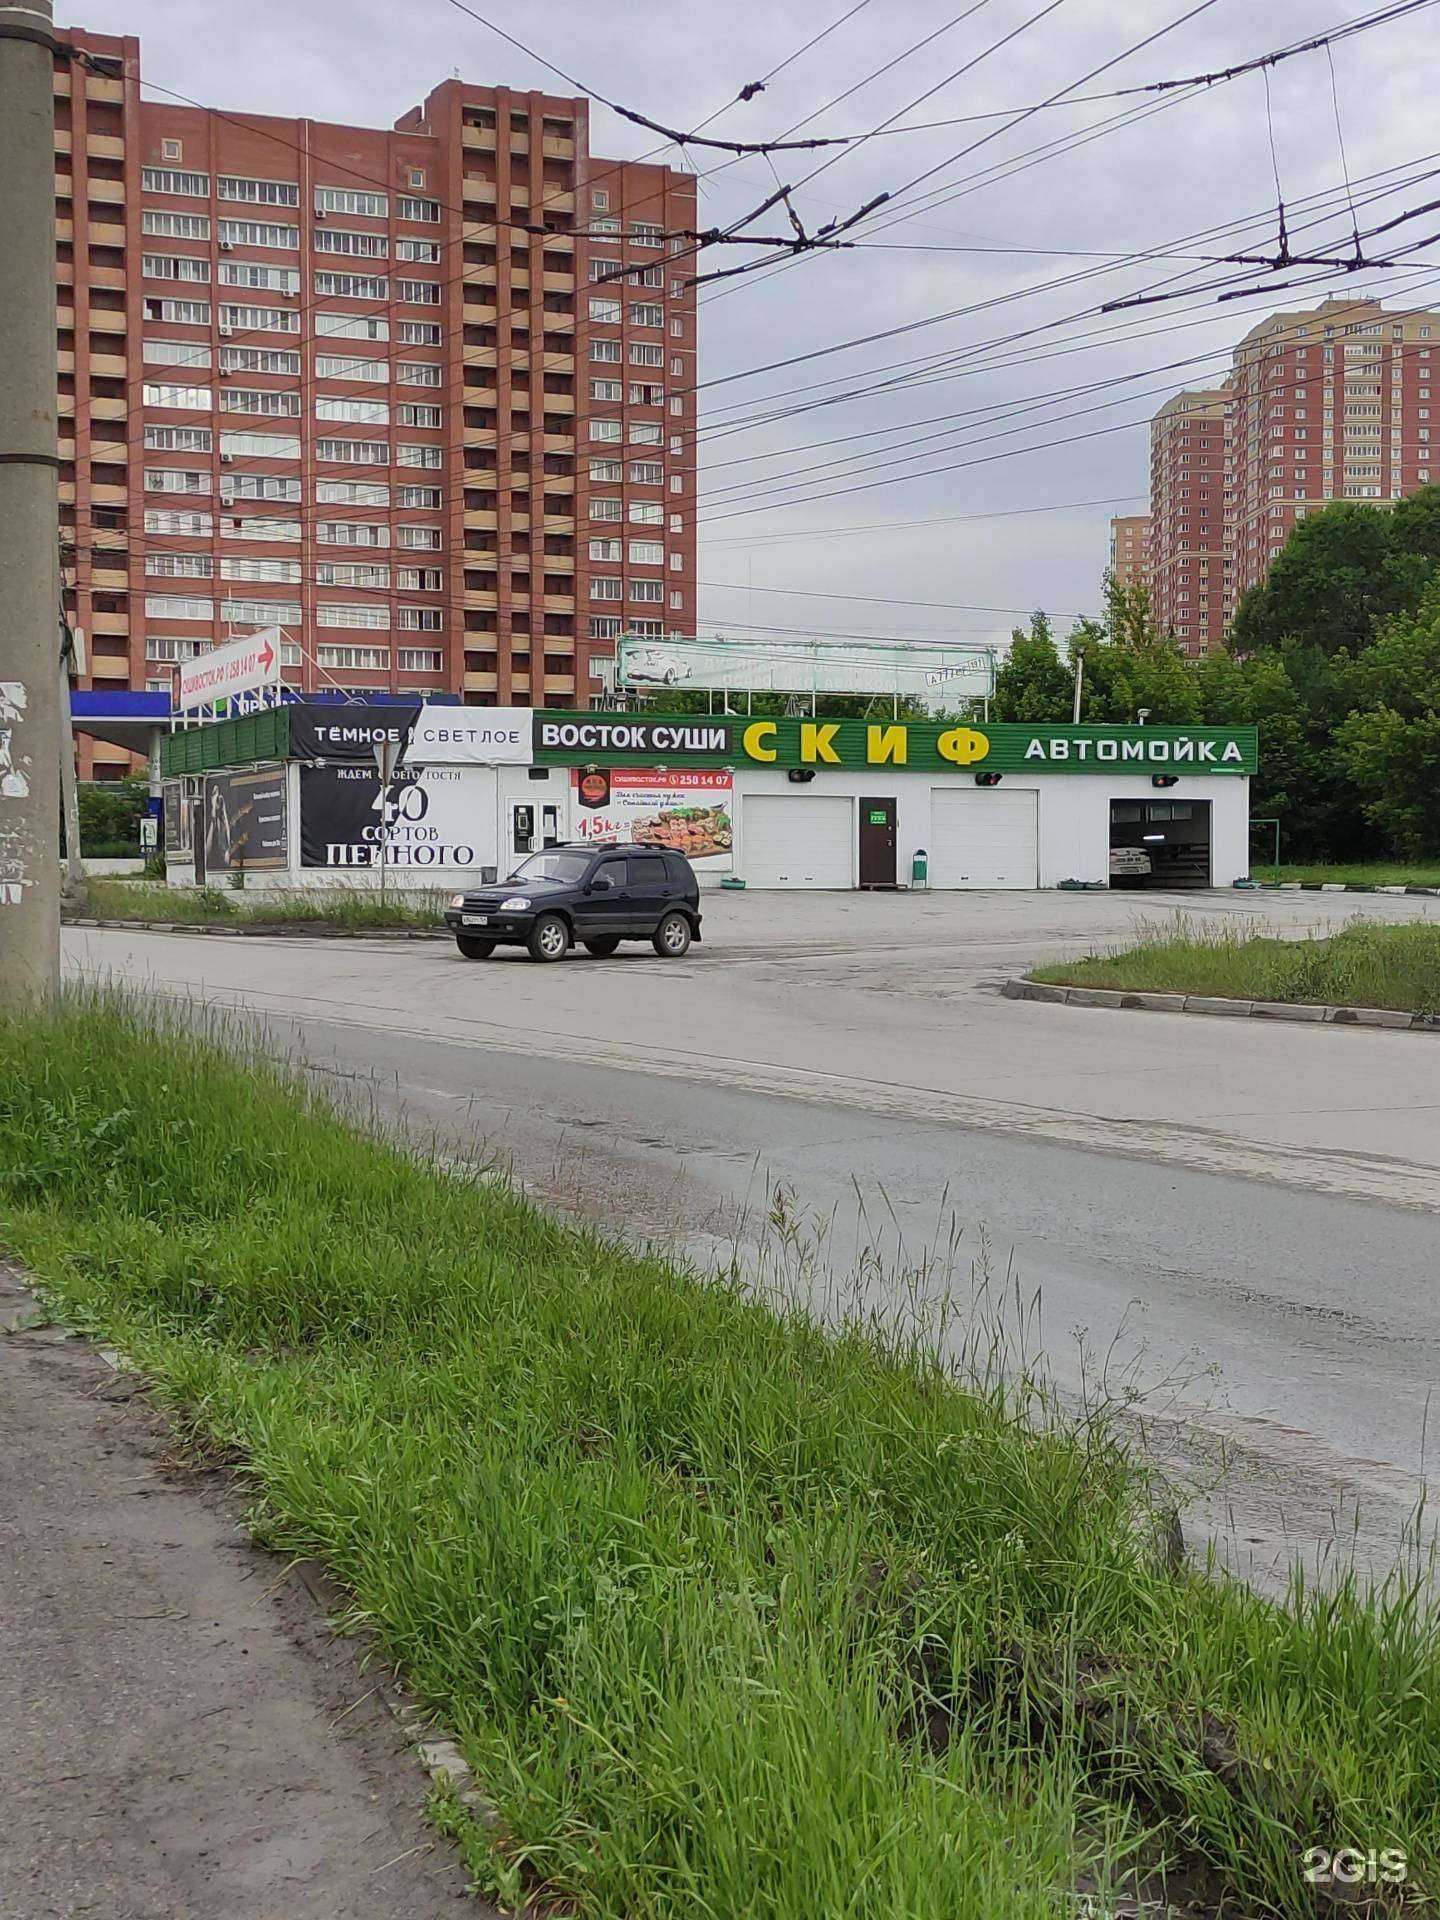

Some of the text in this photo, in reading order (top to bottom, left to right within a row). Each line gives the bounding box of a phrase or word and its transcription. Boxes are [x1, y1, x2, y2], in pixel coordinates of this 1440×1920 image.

[314, 726, 400, 743] ТЁМНОЕ
[423, 729, 520, 744] СВЕТЛОЕ
[542, 724, 726, 750] ВОСТОК СУШИ
[743, 722, 990, 765] СКИФ
[1024, 737, 1243, 762] АВТОМОЙКА
[337, 768, 373, 780] ЖДЕМ
[426, 771, 462, 780] ГОСТЯ
[701, 776, 713, 785] 14
[716, 776, 729, 786] 07
[371, 785, 429, 821] 40
[361, 826, 439, 841] СОРТОВ
[326, 844, 474, 865] ПЕННОГО
